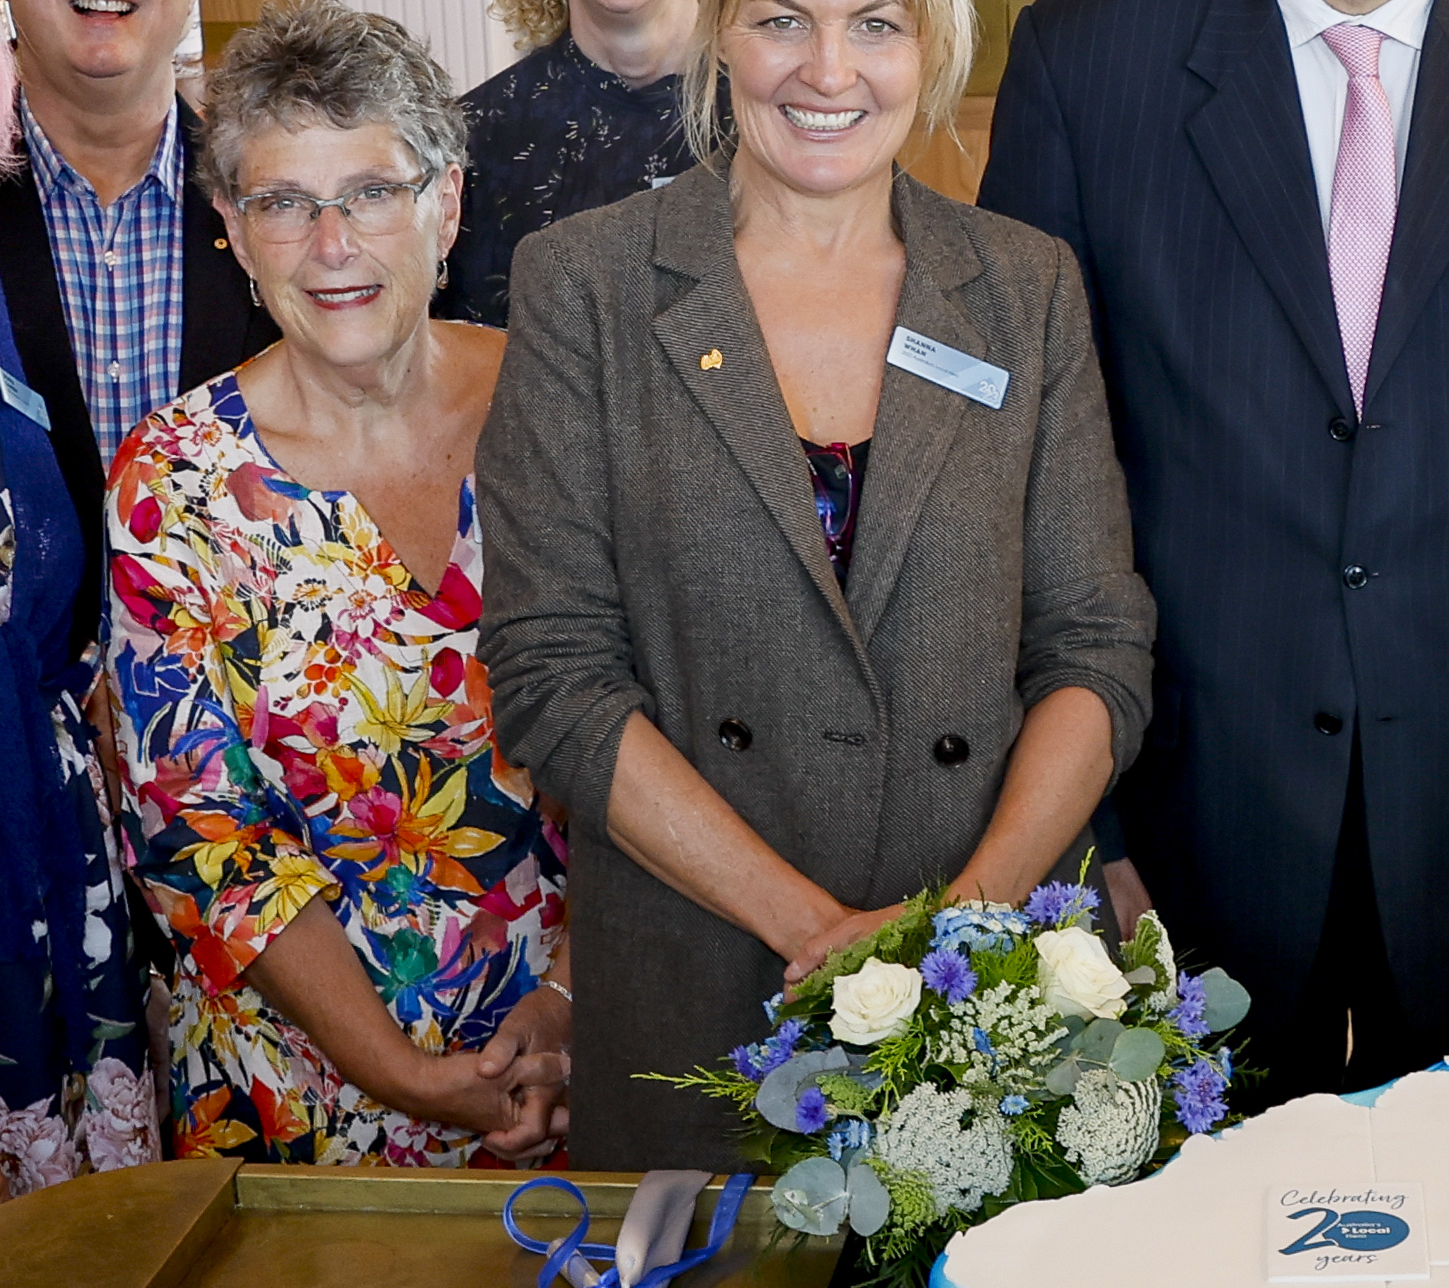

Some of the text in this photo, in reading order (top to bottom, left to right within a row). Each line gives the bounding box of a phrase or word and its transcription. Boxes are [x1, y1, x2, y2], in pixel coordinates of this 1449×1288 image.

[903, 343, 927, 357] WHAN
[905, 335, 937, 353] SHANNA
[1280, 1188, 1409, 1210] Celebrating
[1278, 1207, 1410, 1256] 20
[1352, 1226, 1391, 1235] Local
[1314, 1253, 1379, 1271] years
